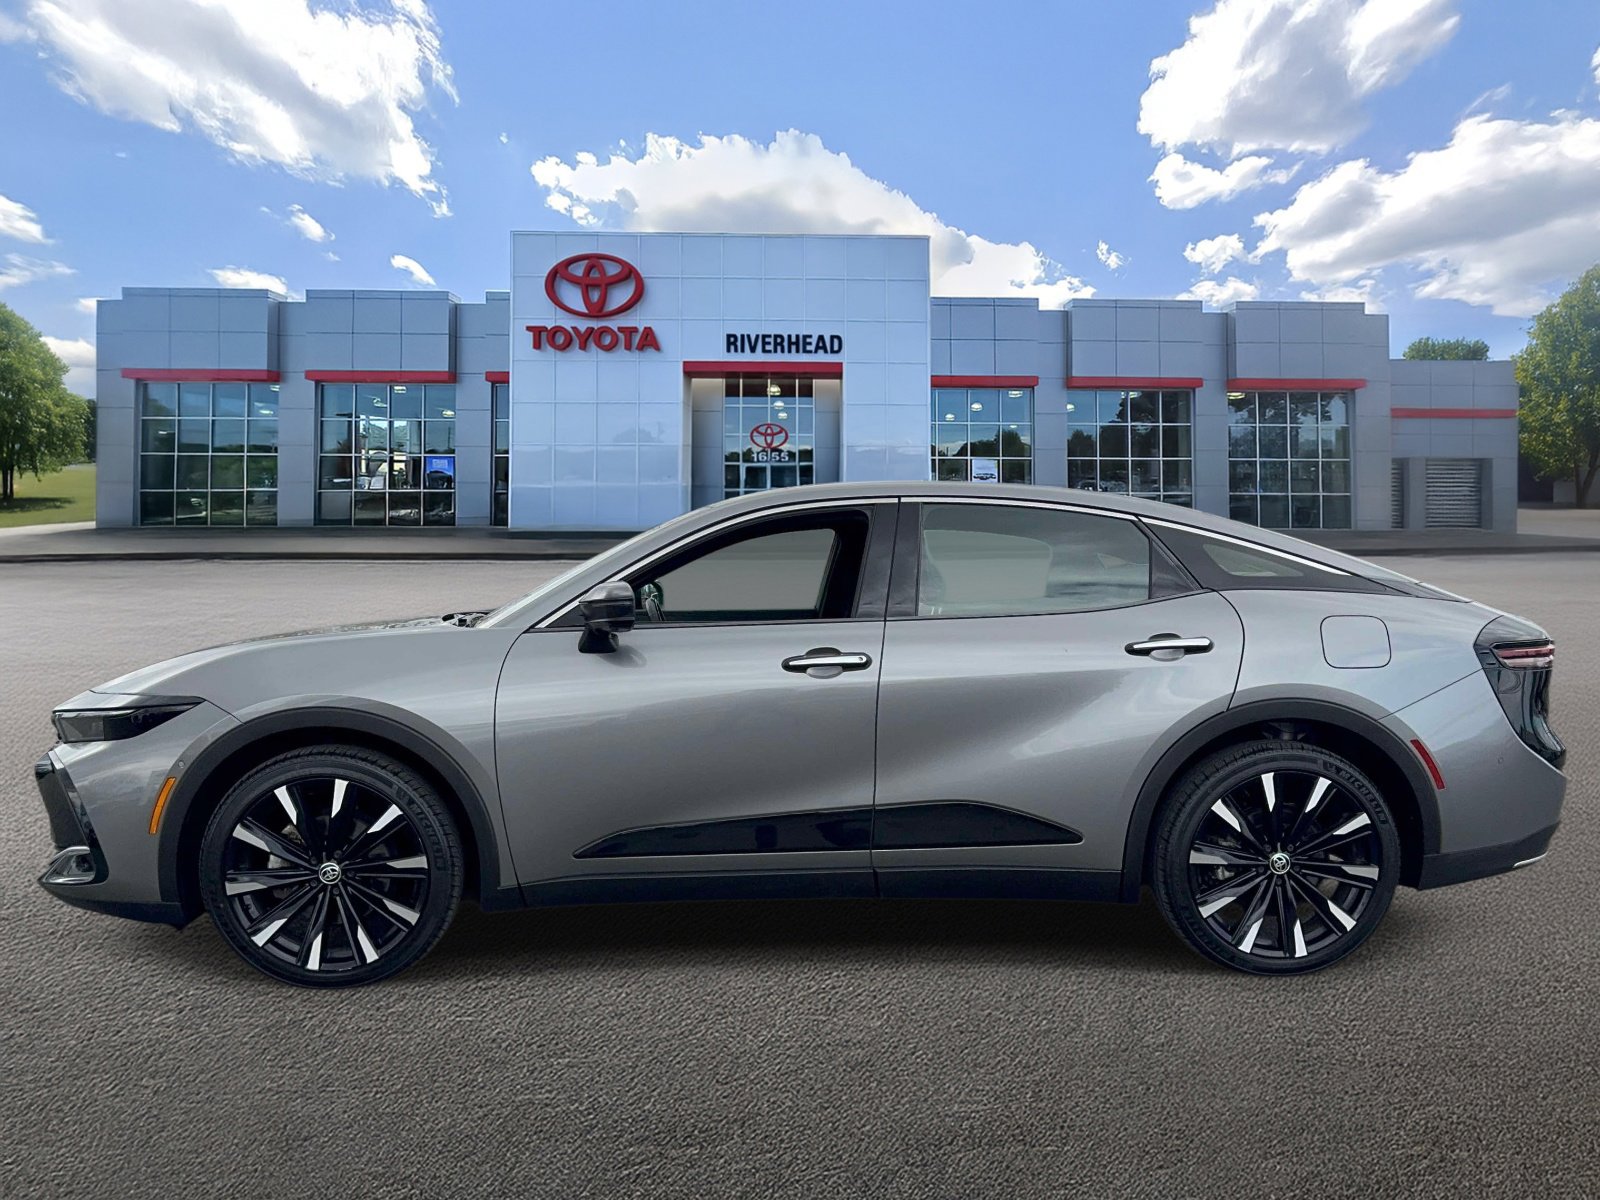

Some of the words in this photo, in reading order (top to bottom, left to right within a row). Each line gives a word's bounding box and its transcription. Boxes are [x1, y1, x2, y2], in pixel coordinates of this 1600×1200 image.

[526, 325, 660, 351] TOYOTA
[726, 333, 843, 354] RIVERHEAD
[751, 451, 789, 462] 1655
[1338, 769, 1388, 823] MICHELIN
